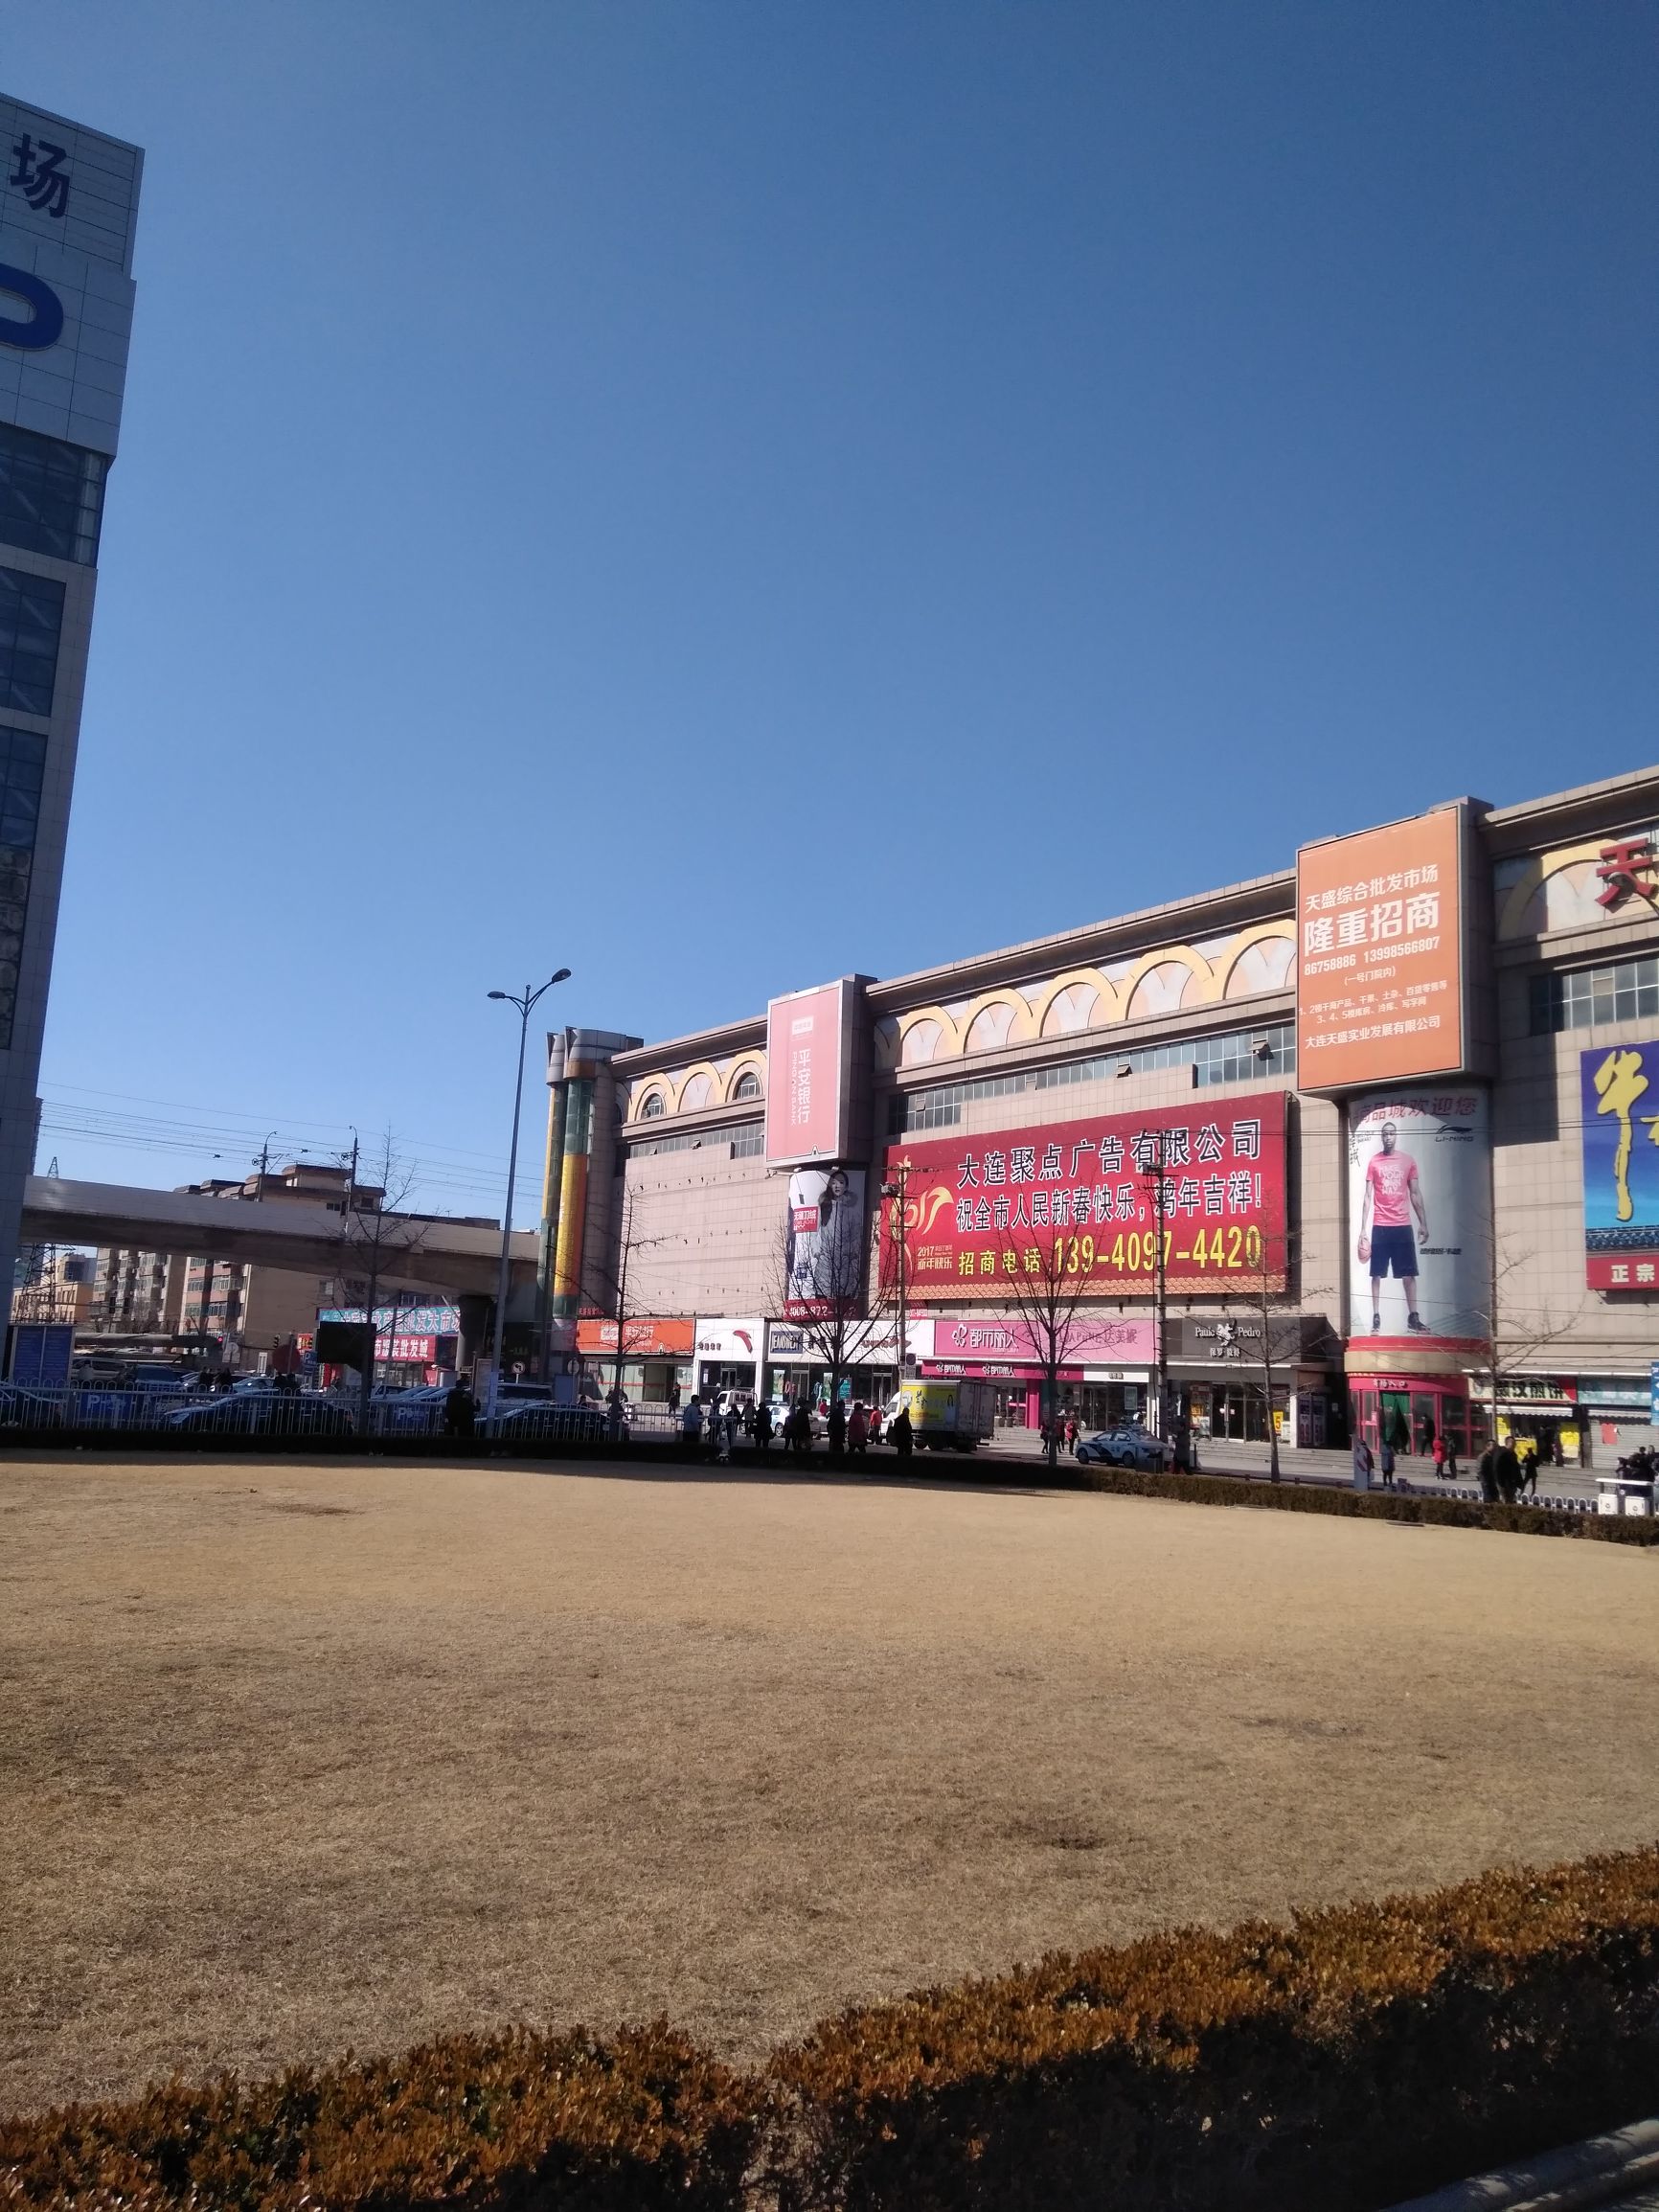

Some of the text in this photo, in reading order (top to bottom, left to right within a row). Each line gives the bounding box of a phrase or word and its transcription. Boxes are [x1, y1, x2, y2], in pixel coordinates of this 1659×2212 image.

[10, 133, 70, 218] 场
[1306, 863, 1439, 914] 天盛综合批发市场
[1304, 891, 1441, 958] 隆重招商
[1304, 936, 1441, 975] 86758886 13998566807
[1305, 1015, 1442, 1050] 大连天盛实业发展有限公司
[798, 1049, 811, 1124] 平安银行
[957, 1118, 1261, 1189] 大连聚点广告有限公司
[918, 1245, 935, 1257] 2017
[918, 1256, 953, 1270] 新年快乐
[1054, 1225, 1261, 1274] 139-4097-4420
[1611, 1263, 1655, 1283] 正宗
[969, 1329, 1019, 1348] 都市丽人
[1238, 1327, 1261, 1337] Pedro
